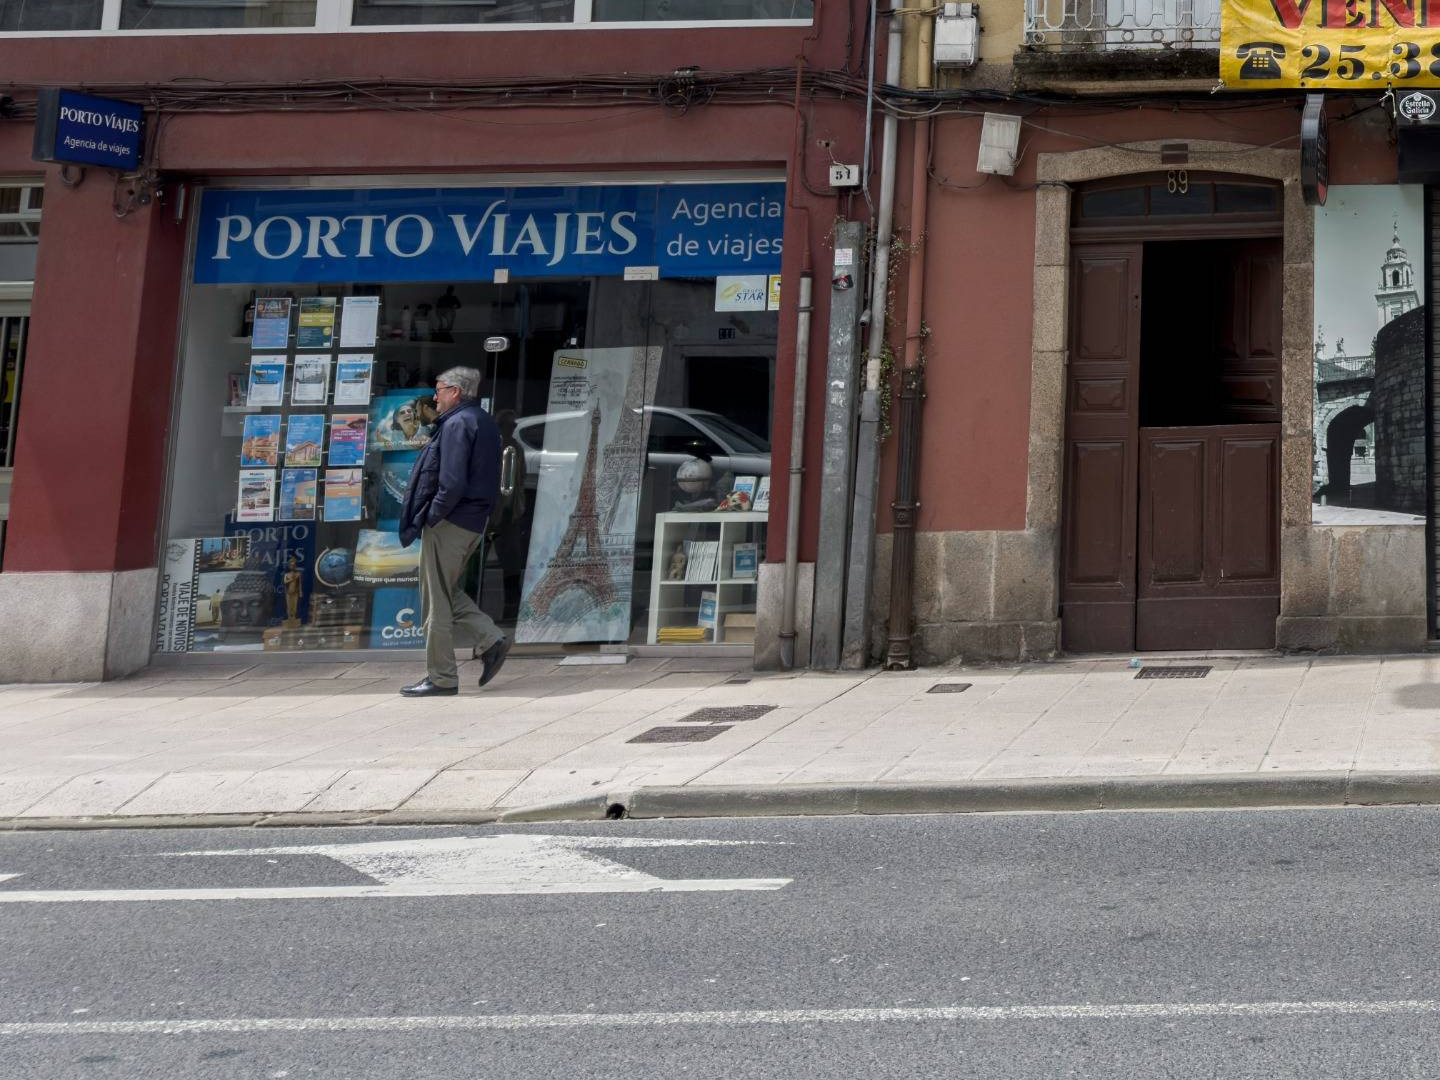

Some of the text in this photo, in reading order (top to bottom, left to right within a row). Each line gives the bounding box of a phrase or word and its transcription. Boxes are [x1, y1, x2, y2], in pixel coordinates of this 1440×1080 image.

[59, 106, 139, 133] PORTO VIAJES
[64, 136, 130, 156] Agencia de viajes
[1167, 170, 1188, 193] 89
[672, 197, 781, 226] Agencia
[211, 200, 638, 266] PORTO VIAJES
[667, 234, 783, 262] de viajes
[736, 292, 764, 301] STAR
[174, 581, 191, 651] VIAJE DE NOVIOS
